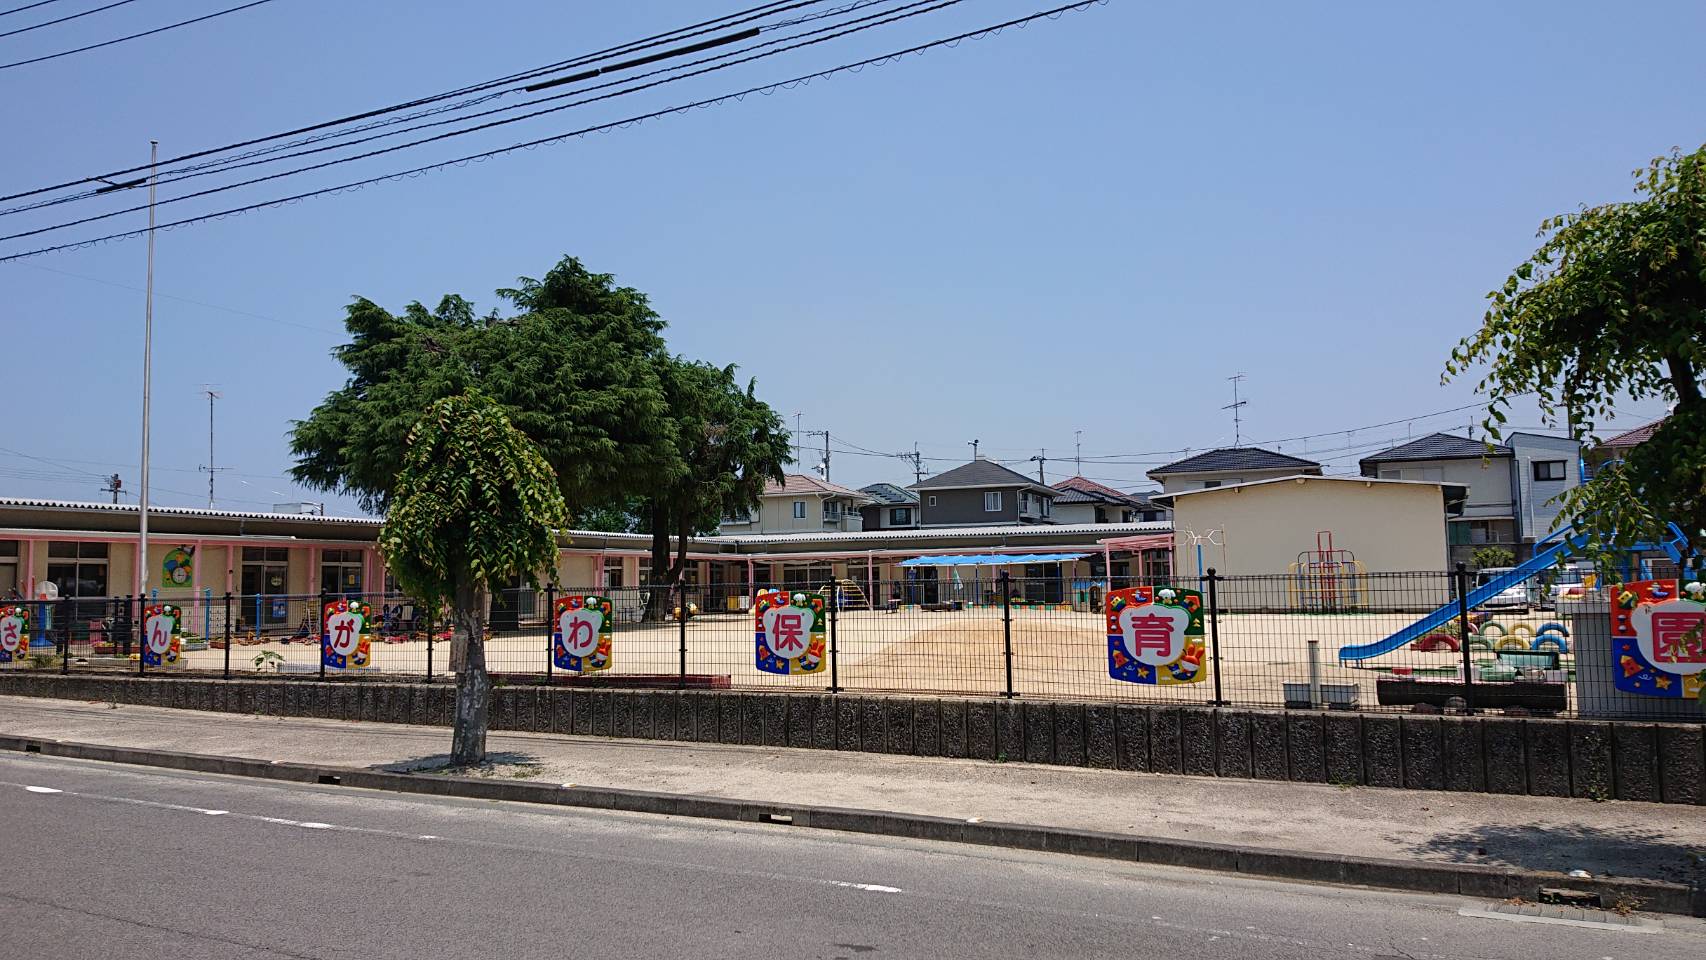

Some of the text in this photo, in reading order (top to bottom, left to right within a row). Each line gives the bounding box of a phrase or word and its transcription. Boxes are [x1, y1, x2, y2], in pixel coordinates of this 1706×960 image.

[4, 622, 17, 646] さ
[151, 621, 168, 647] ん
[334, 618, 355, 648] が
[568, 616, 593, 650] わ
[772, 613, 803, 651] 保
[1131, 613, 1174, 657] 育
[1651, 612, 1706, 663] 園
